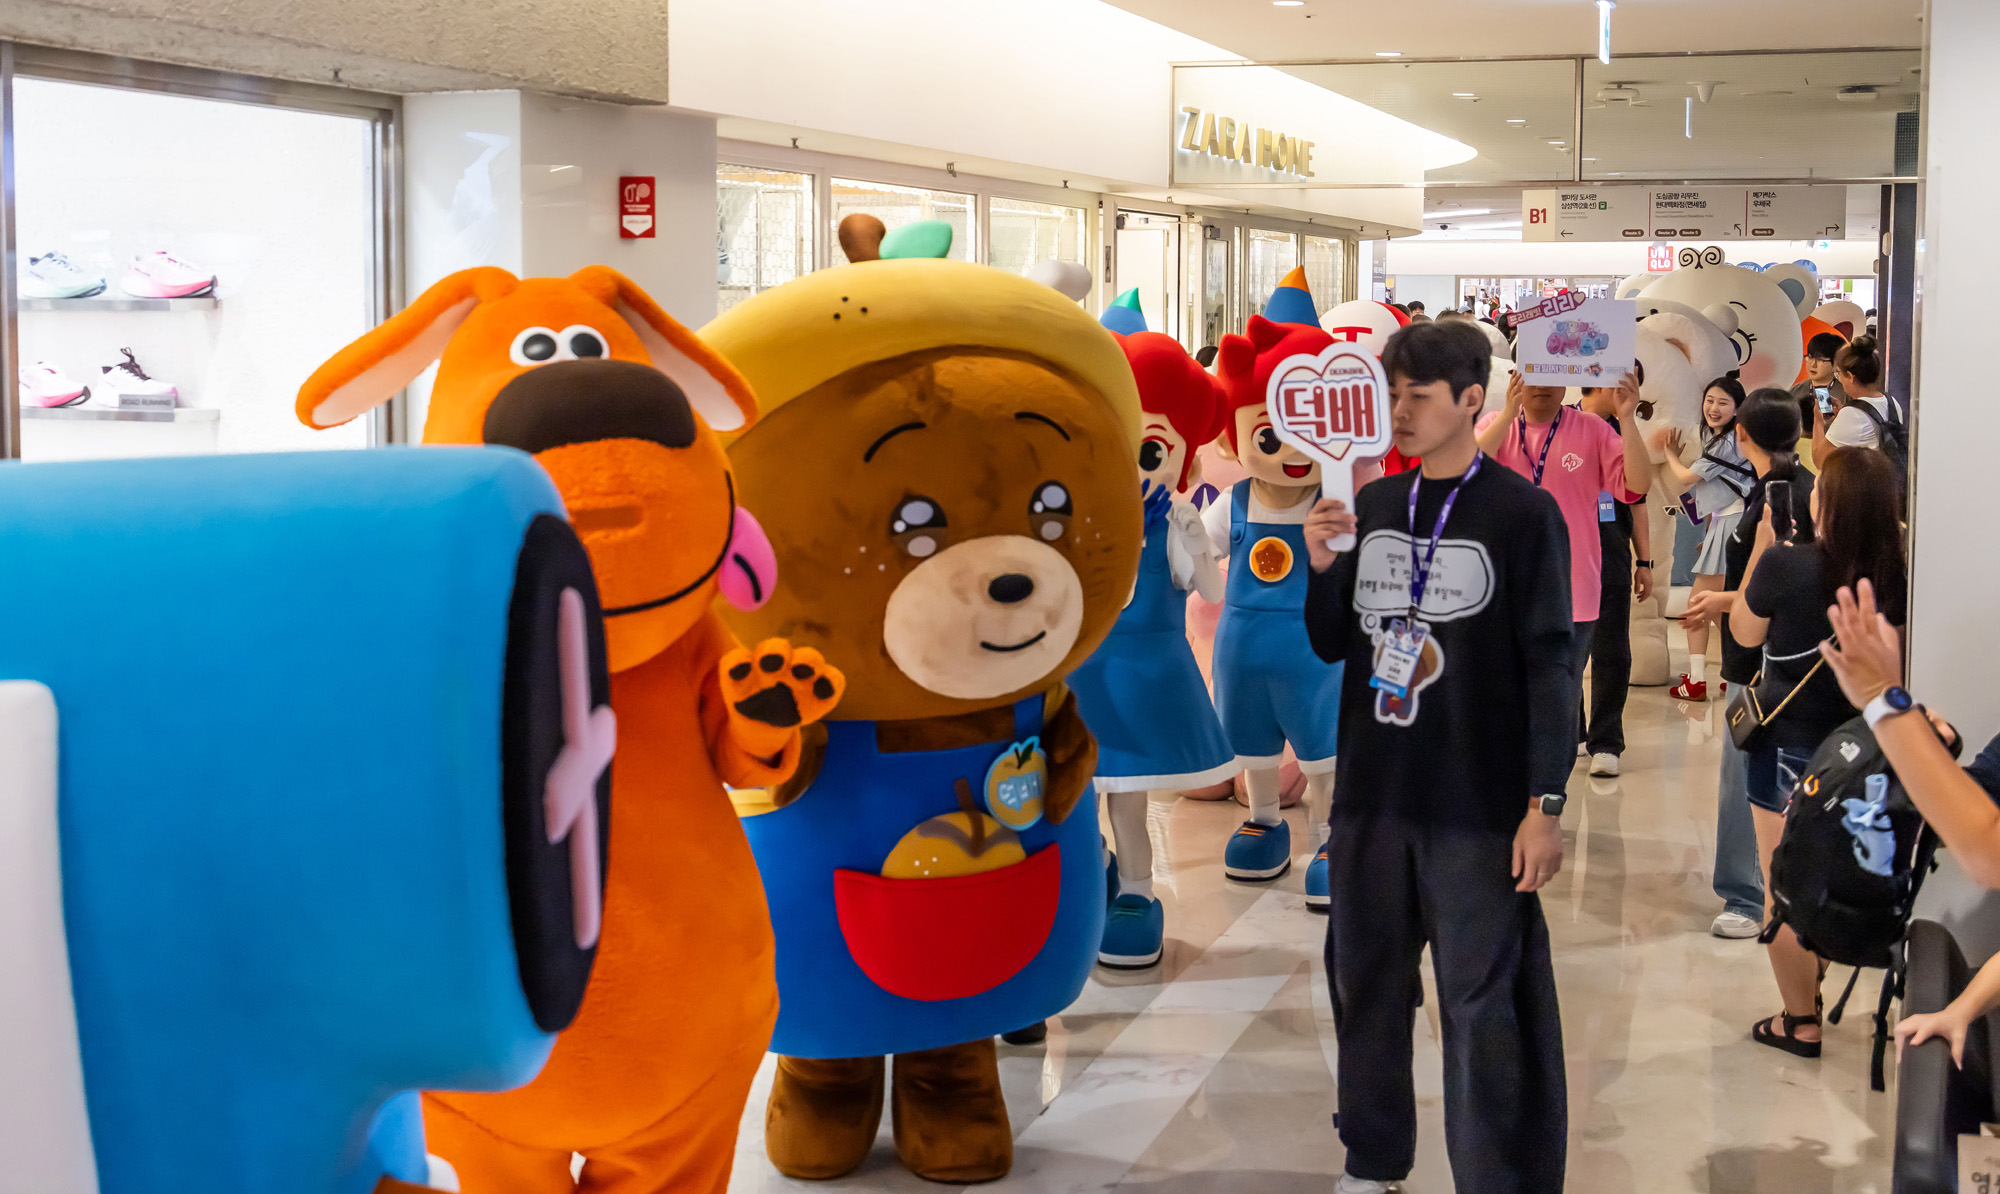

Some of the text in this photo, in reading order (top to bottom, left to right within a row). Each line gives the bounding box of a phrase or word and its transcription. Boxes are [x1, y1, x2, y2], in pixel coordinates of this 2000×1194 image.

[1181, 105, 1316, 178] ZARA HOME
[1561, 193, 1598, 201] 별마당 도서관
[1656, 192, 1699, 200] 도심공항 리무진
[1752, 191, 1777, 199] 메가박스
[1752, 200, 1771, 208] 우체국
[1529, 207, 1547, 225] B1
[1650, 247, 1670, 258] UNI
[1650, 259, 1671, 270] QLO
[1542, 292, 1576, 317] 리리
[121, 398, 140, 406] ROAD
[1283, 383, 1376, 439] 덕배
